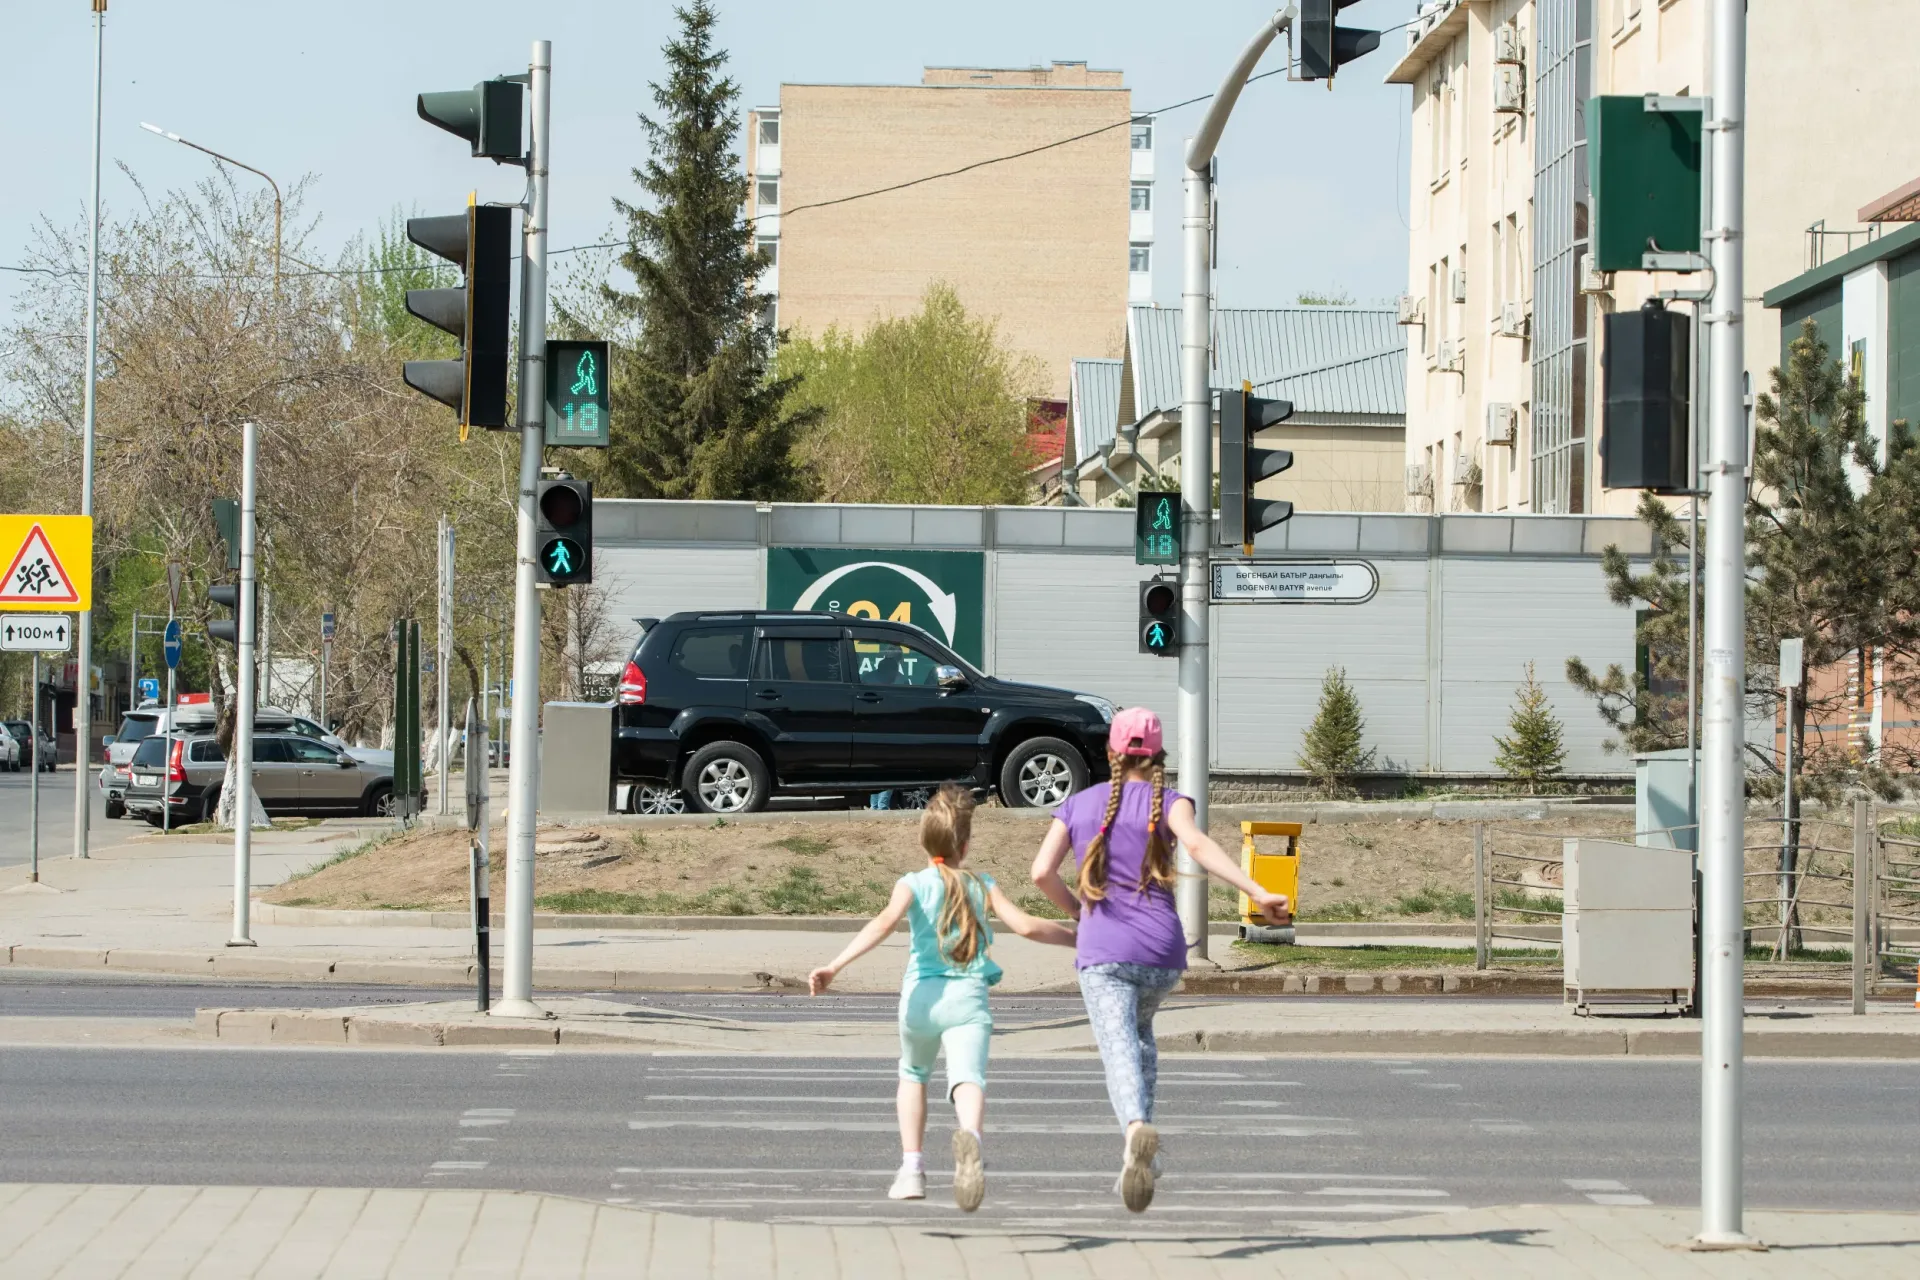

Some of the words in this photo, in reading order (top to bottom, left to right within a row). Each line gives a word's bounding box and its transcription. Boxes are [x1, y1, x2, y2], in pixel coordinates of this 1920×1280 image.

[562, 402, 598, 431] 18
[1147, 534, 1172, 555] 18
[1236, 571, 1278, 579] БӨГЕНБАЙ
